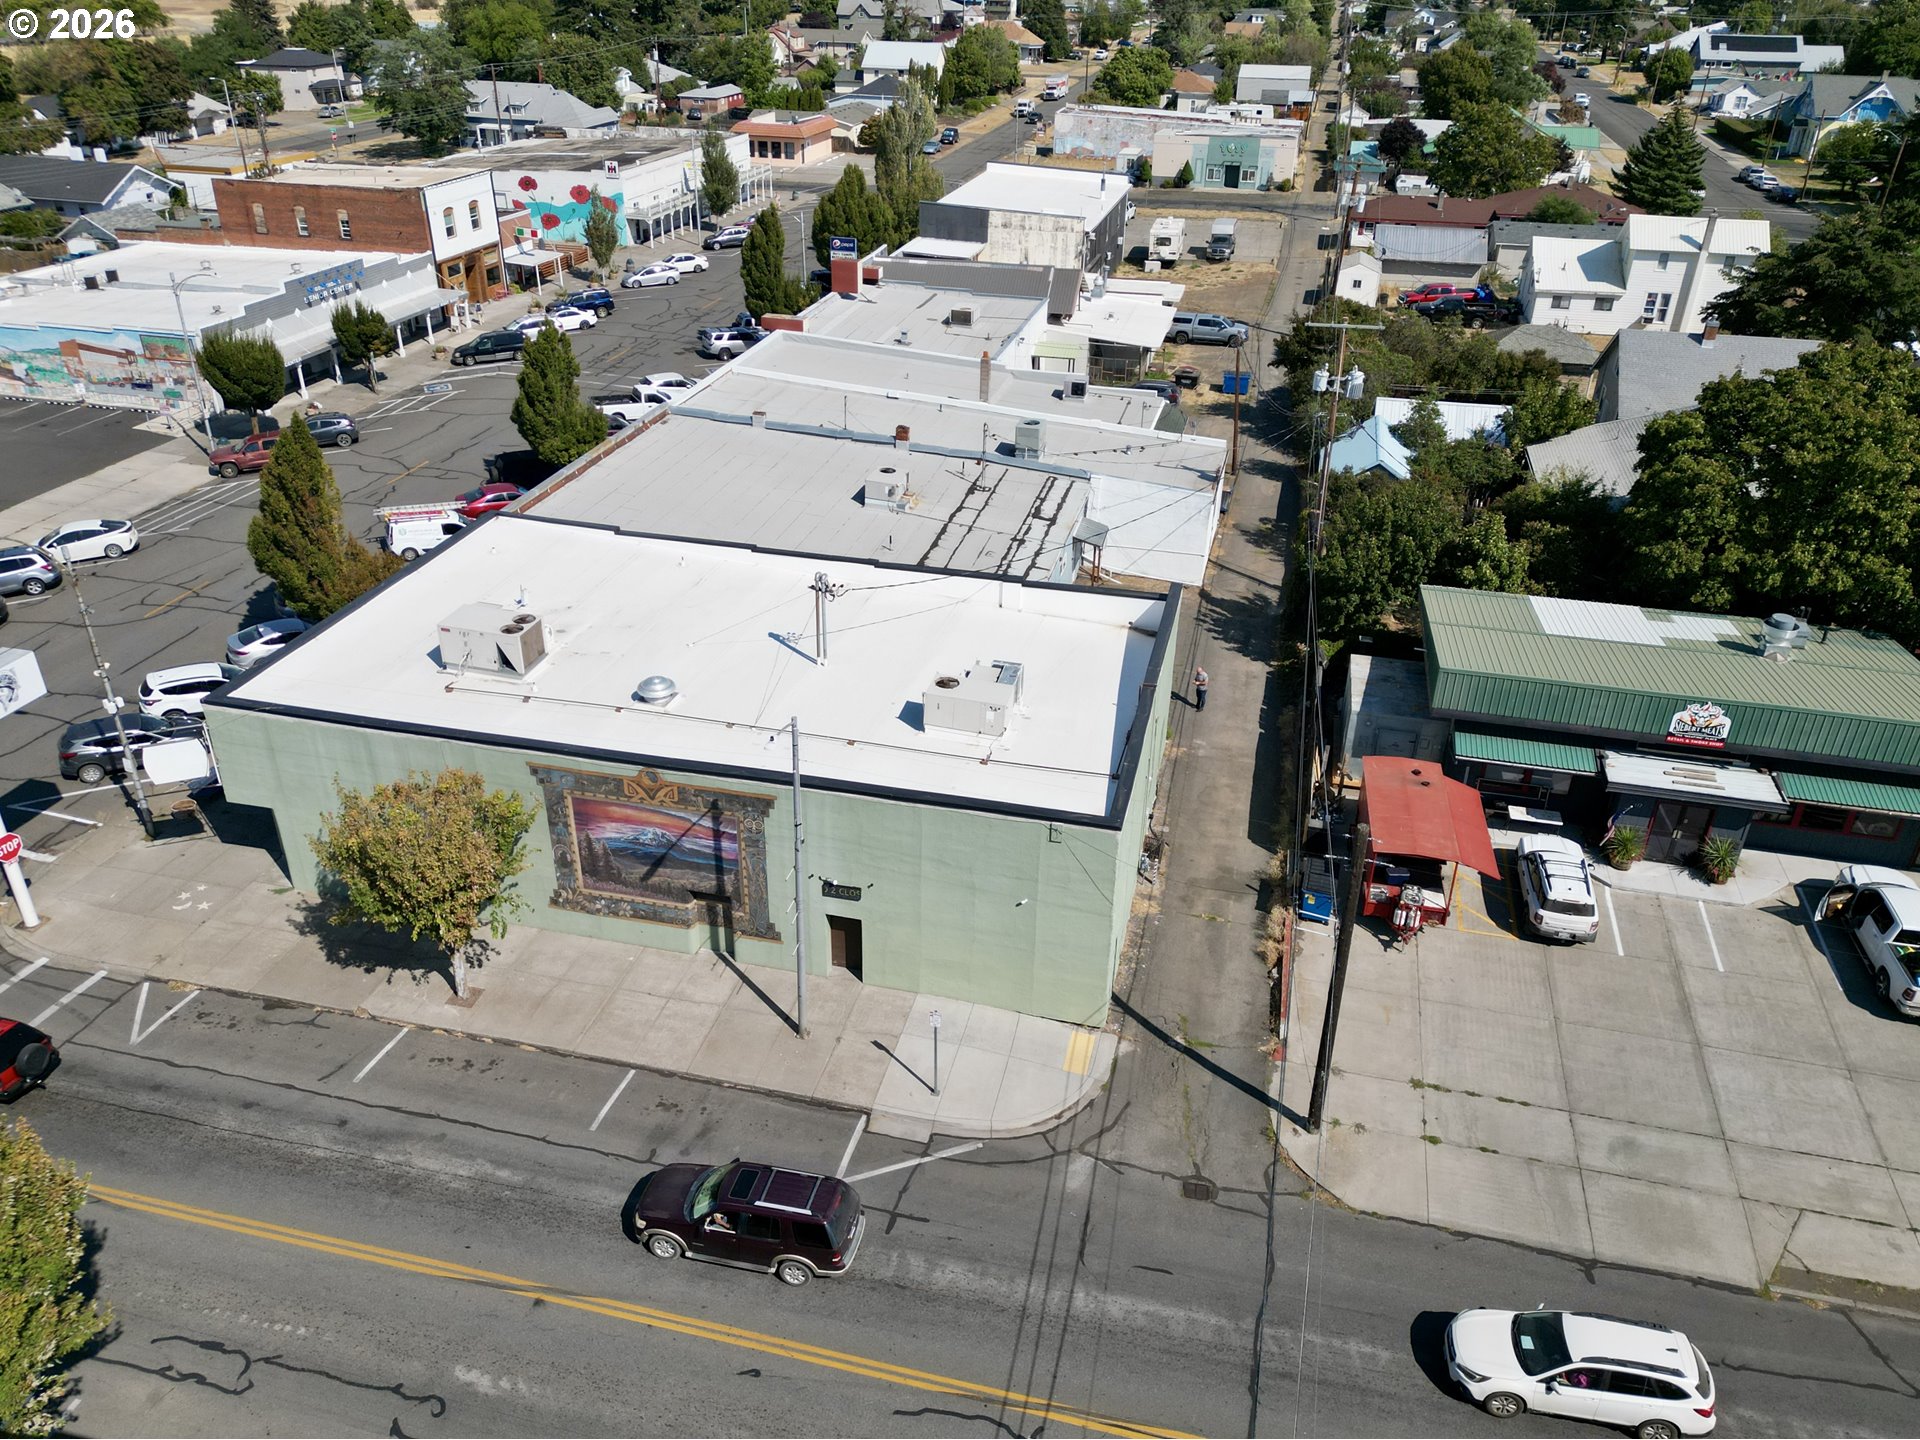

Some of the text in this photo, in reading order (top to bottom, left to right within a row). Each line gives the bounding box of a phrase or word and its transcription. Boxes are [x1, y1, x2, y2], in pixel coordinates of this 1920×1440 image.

[329, 283, 353, 294] CENTER
[1673, 720, 1725, 736] SIEBERT MEATS
